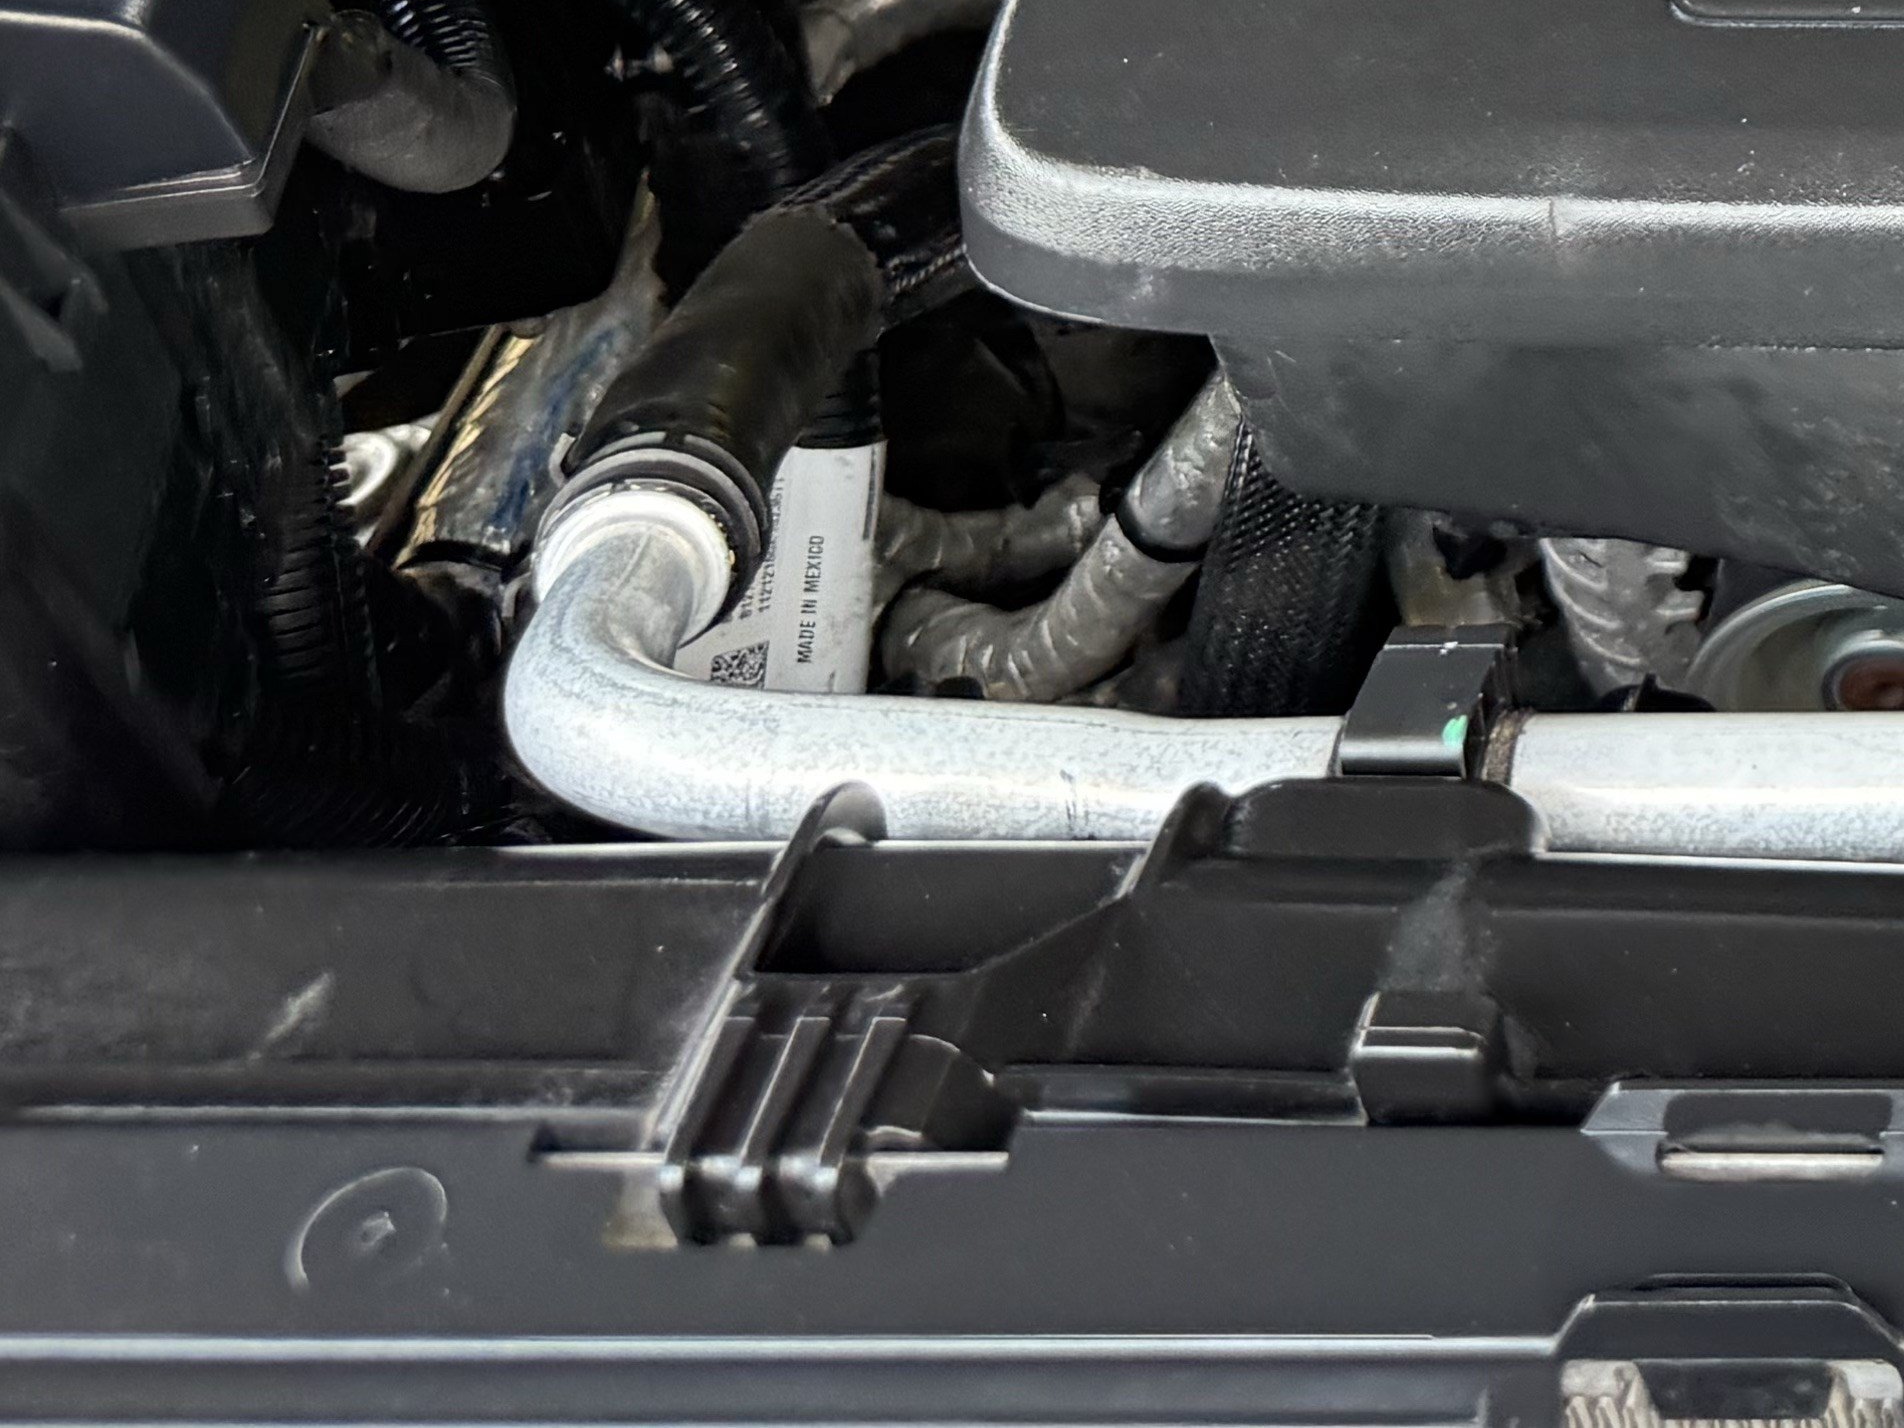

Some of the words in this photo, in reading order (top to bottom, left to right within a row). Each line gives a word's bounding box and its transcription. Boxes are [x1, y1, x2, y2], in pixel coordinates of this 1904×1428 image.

[804, 535, 824, 593] MEXICO
[801, 598, 818, 615] IN
[797, 620, 816, 664] MADE
